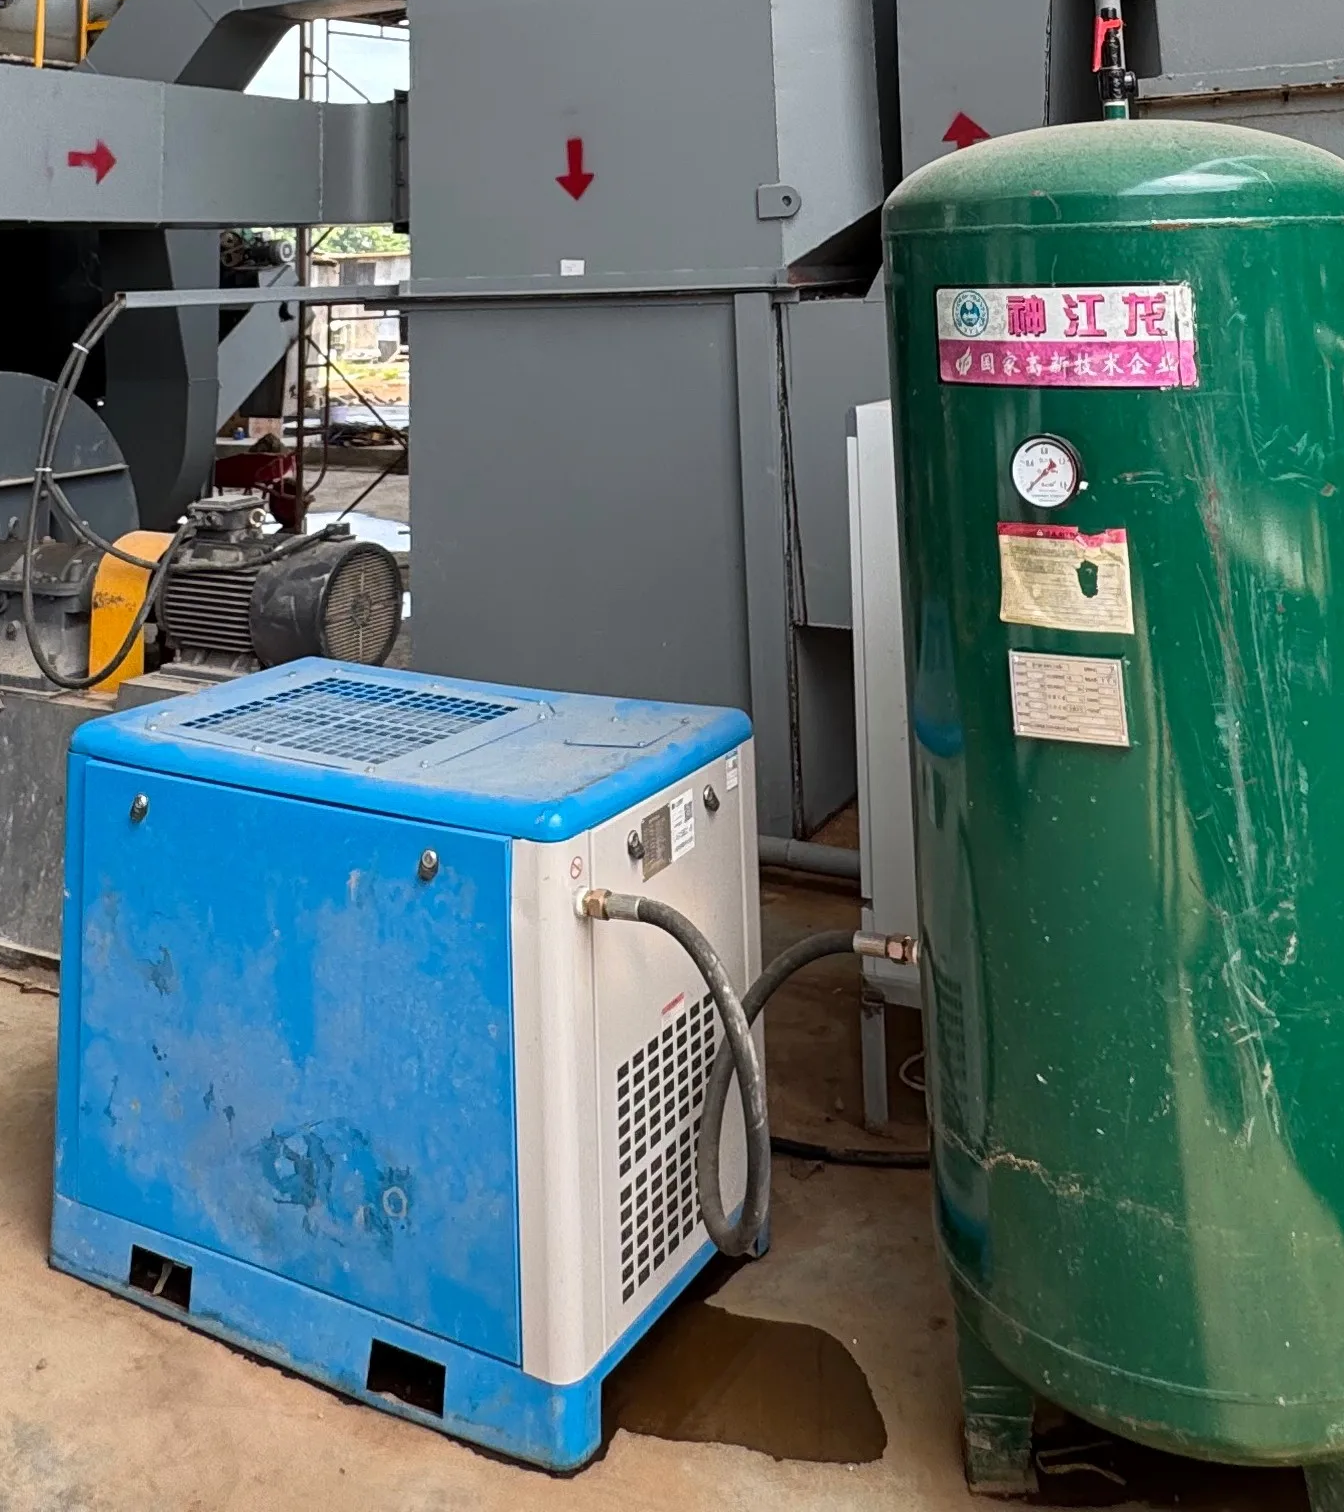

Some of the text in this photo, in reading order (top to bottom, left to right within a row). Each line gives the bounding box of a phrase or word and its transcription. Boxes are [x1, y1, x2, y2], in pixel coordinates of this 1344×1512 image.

[980, 350, 1179, 377] 国家高新技术企业
